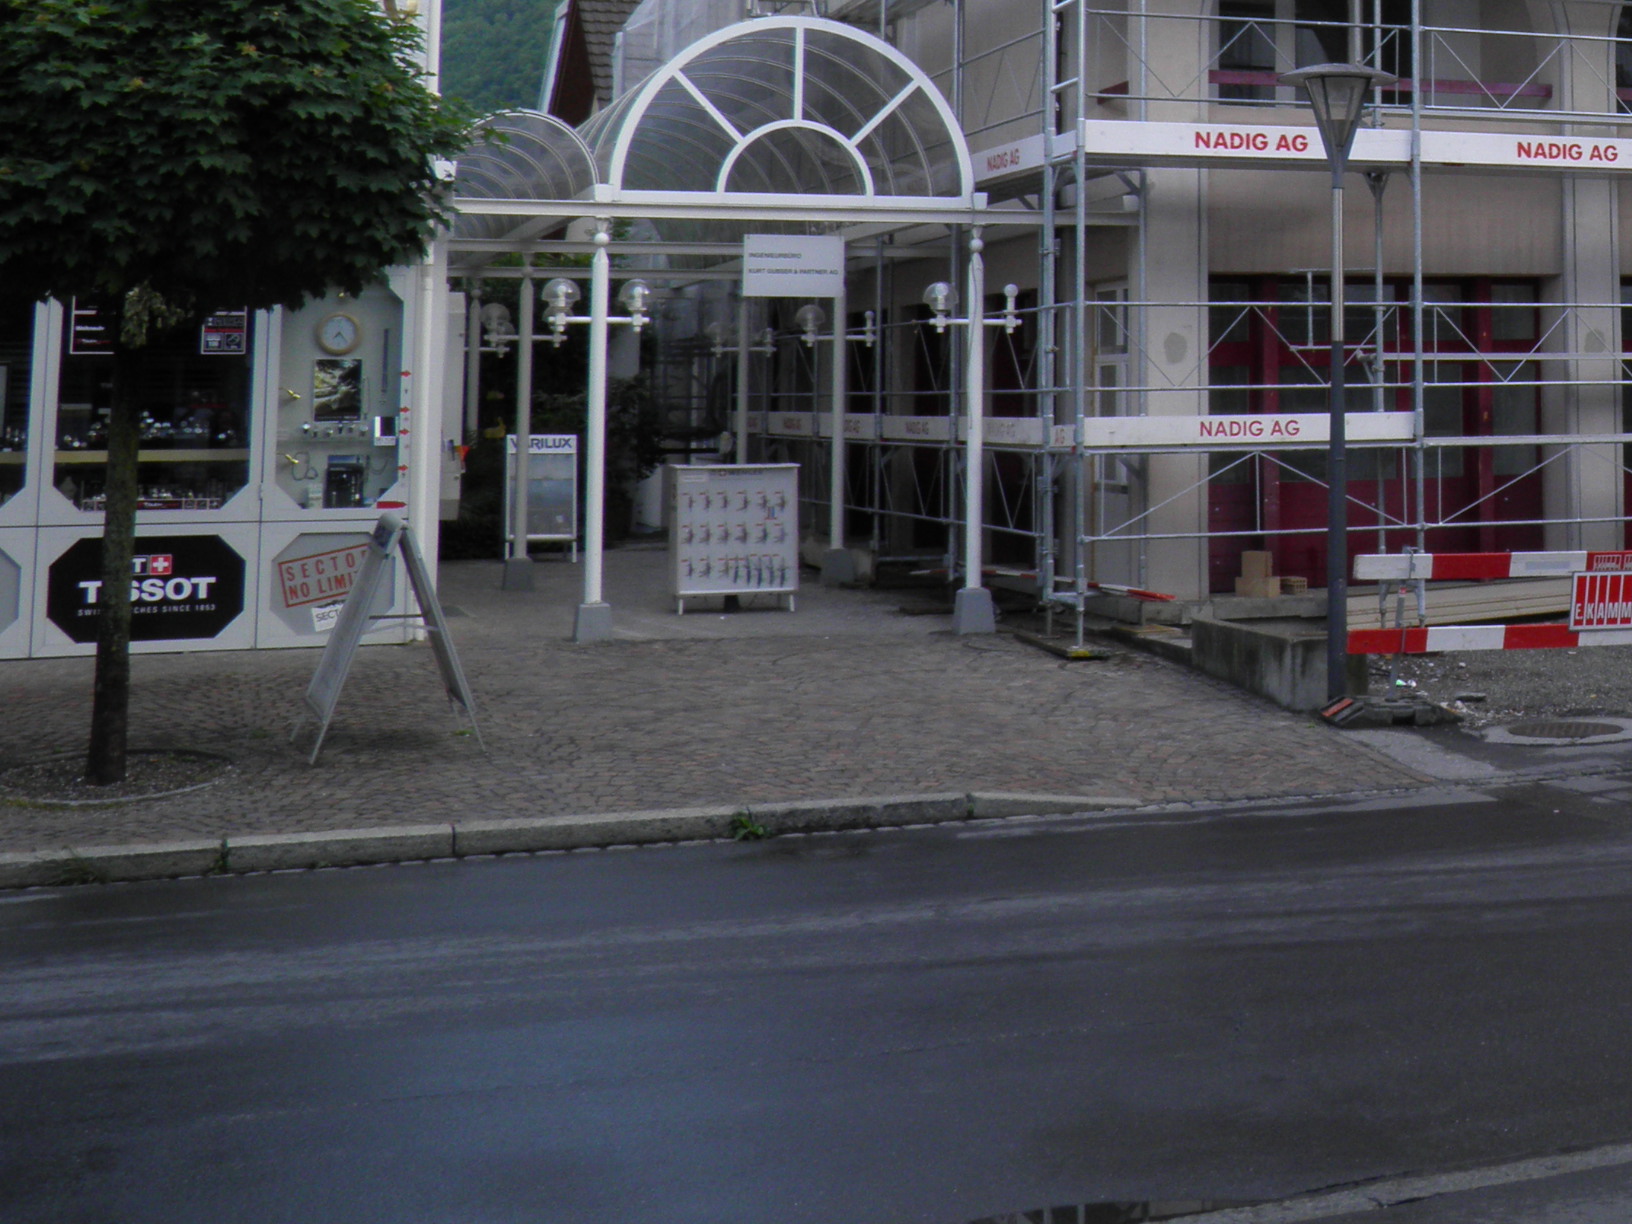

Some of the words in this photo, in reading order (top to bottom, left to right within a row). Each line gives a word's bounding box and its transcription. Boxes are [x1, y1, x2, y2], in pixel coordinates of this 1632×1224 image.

[1195, 132, 1269, 152] NADIG
[1276, 135, 1309, 153] AG
[1517, 142, 1583, 161] NADIG
[1590, 145, 1618, 162] AG
[1199, 420, 1264, 438] NADIG
[1271, 420, 1301, 437] AG
[510, 438, 572, 450] VRILUX
[78, 577, 217, 604] TSOT
[288, 582, 311, 600] NO
[317, 570, 359, 594] LIMI
[162, 605, 191, 613] SINCE
